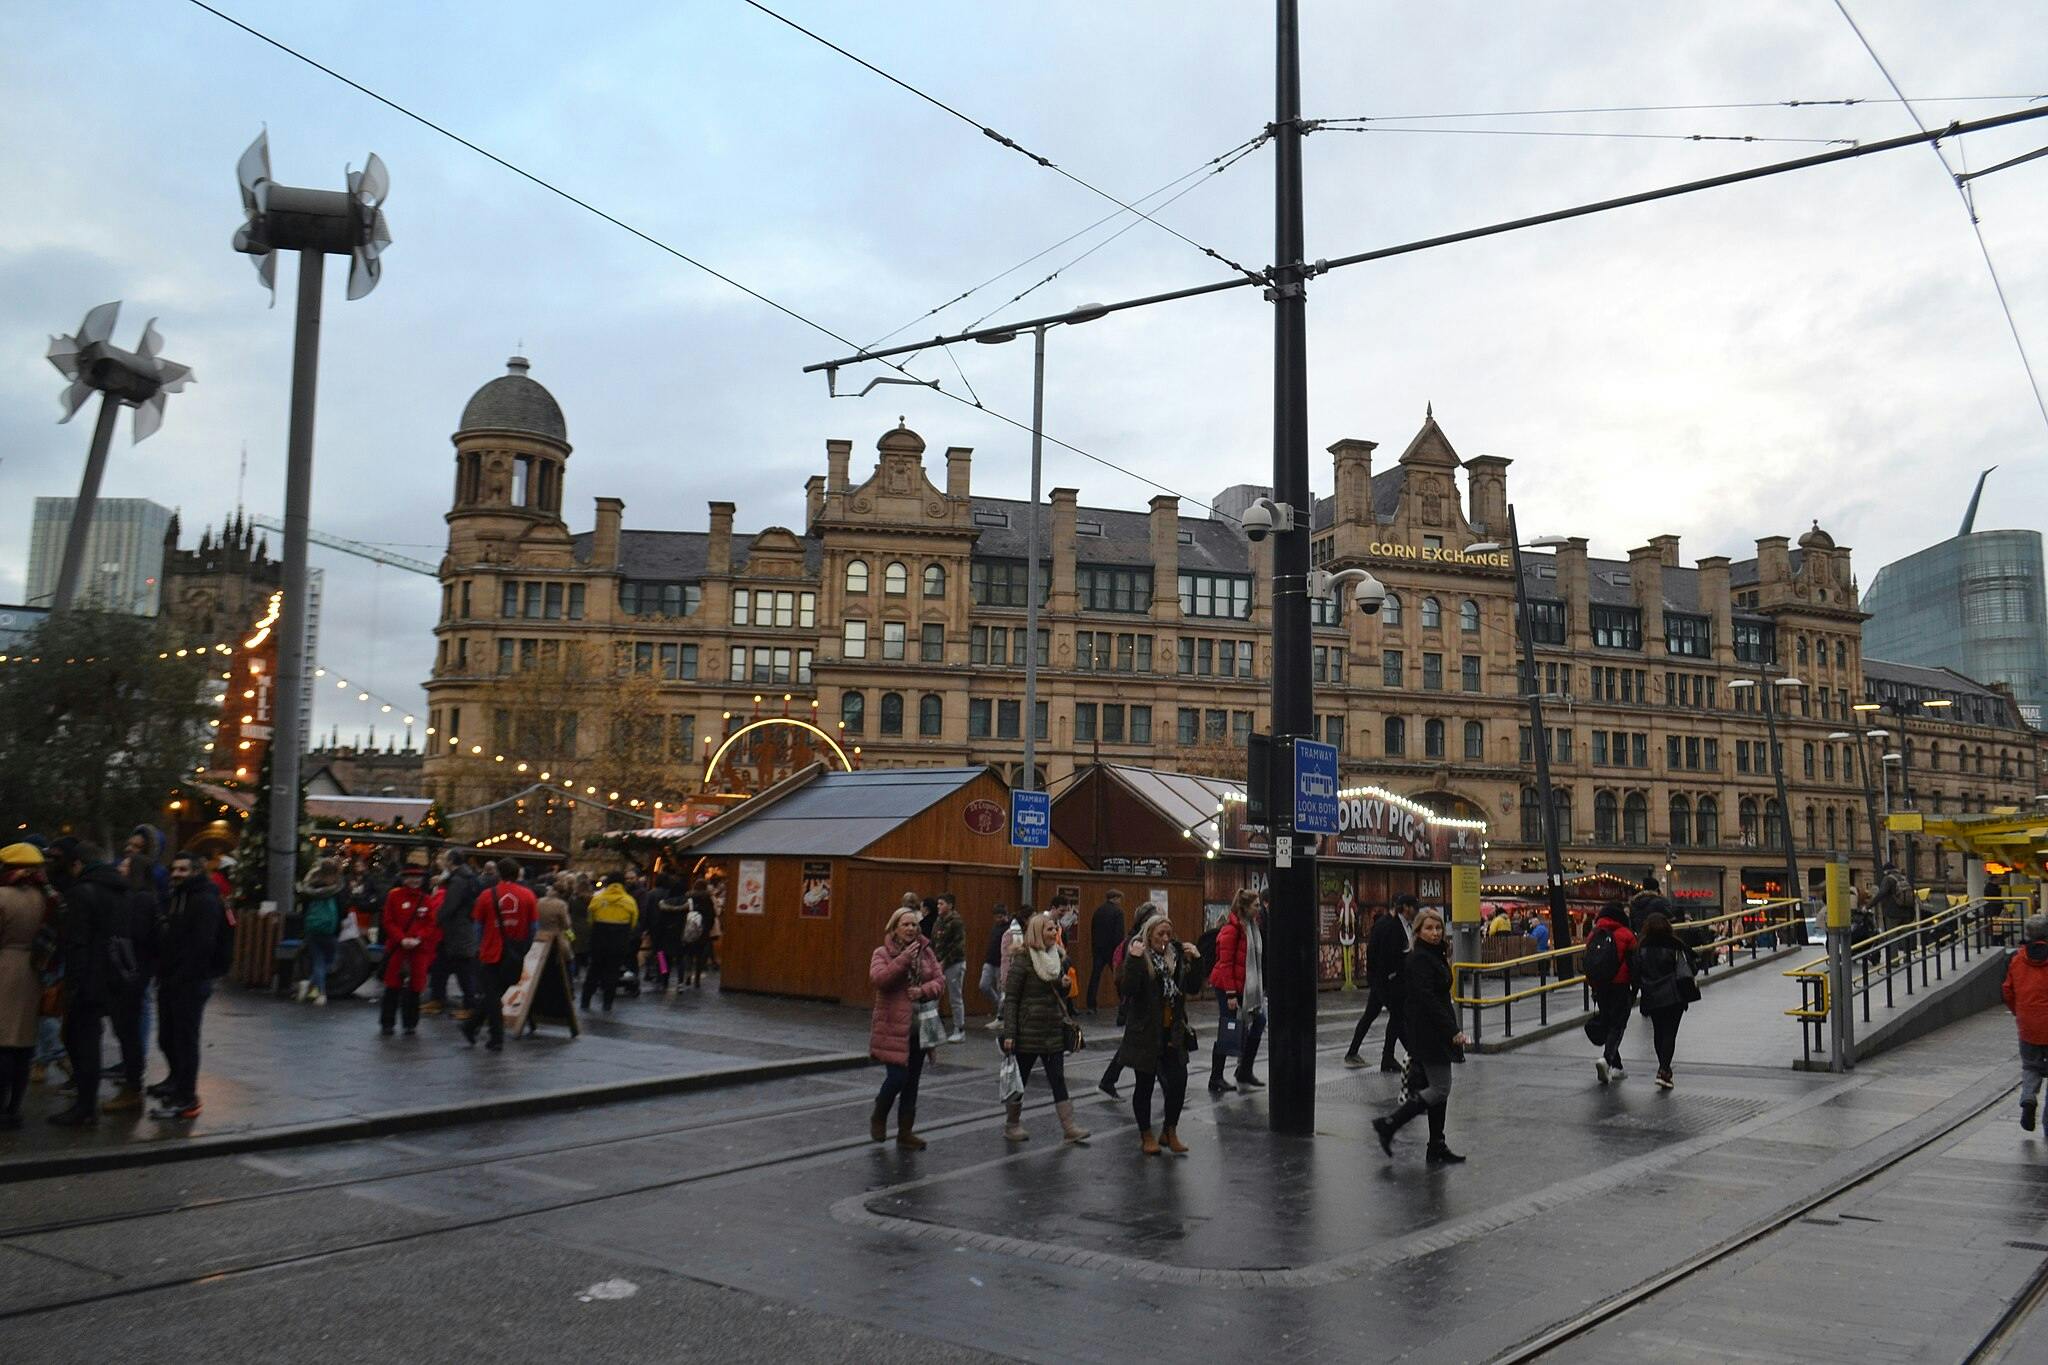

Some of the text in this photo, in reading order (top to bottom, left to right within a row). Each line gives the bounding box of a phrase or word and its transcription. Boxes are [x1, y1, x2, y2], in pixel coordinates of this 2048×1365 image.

[1369, 541, 1510, 568] CORN EXCHANGE
[1300, 746, 1333, 762] TRAMWAY
[1018, 794, 1046, 804] TRAMWAY
[1298, 801, 1337, 815] LOOK BOTH
[1308, 815, 1328, 828] WAYS
[1338, 799, 1414, 843] ORKY PIG
[1031, 828, 1047, 836] BOTH
[1336, 841, 1406, 857] YORKSHIRE PUDDING WRAP
[1251, 871, 1269, 893] BA
[1421, 879, 1441, 898] BAR
